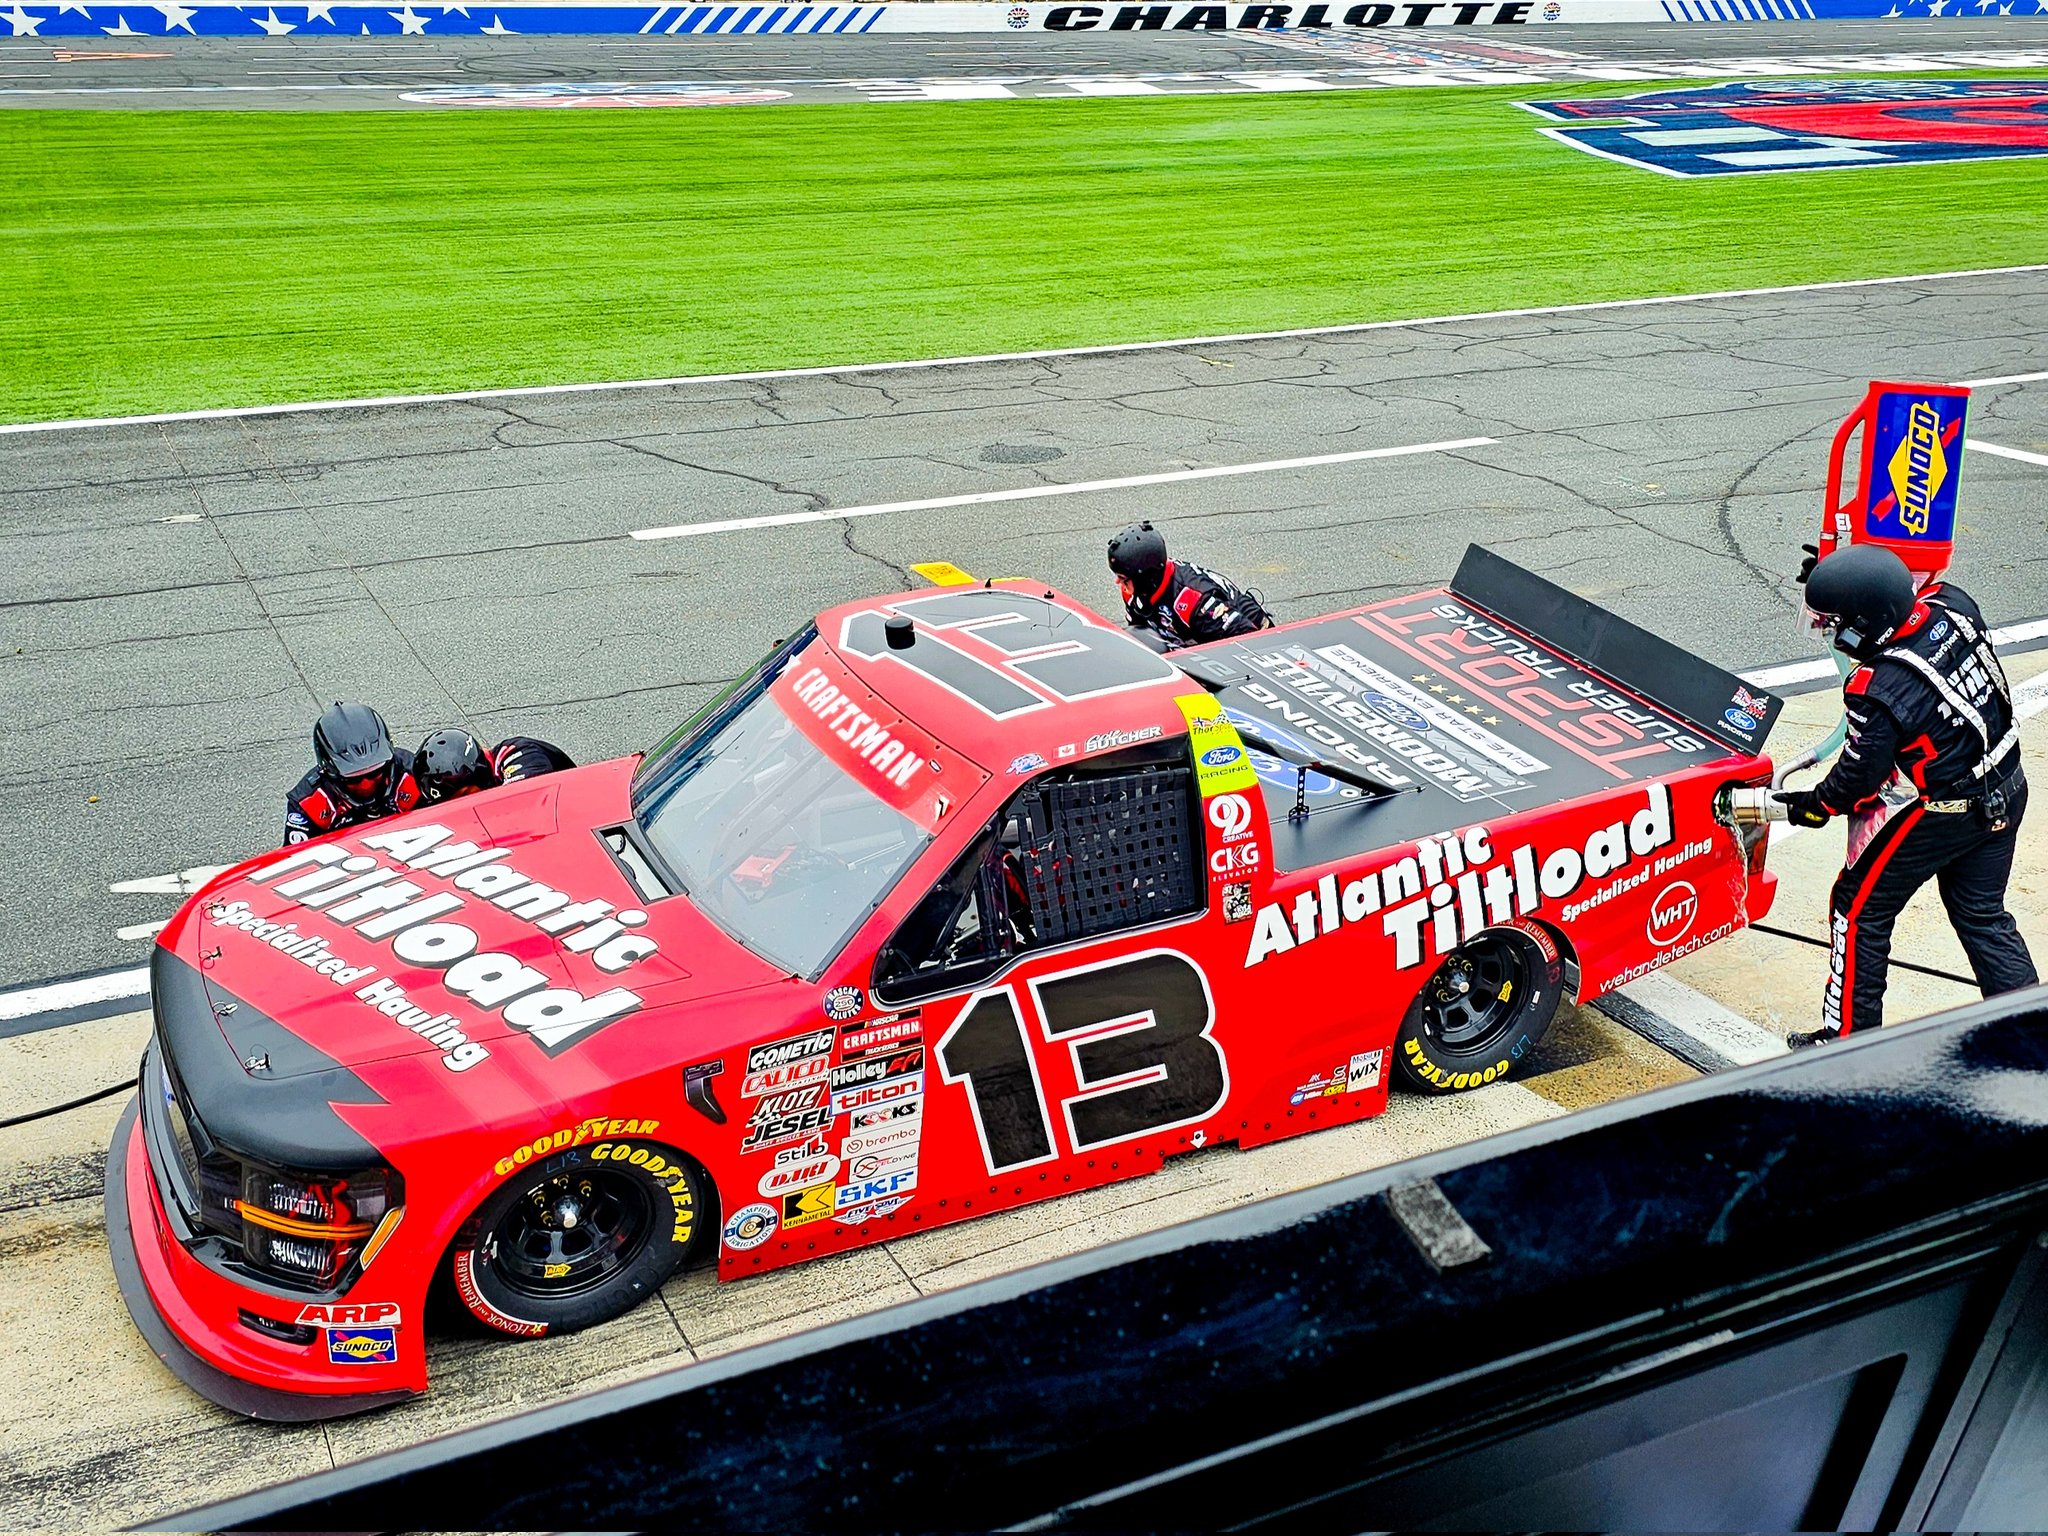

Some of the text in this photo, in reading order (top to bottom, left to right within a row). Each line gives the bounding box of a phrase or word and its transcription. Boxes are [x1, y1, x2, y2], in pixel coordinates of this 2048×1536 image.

[1043, 2, 1548, 31] CHARLOTTE
[1903, 408, 1937, 529] SUNOCO
[1876, 627, 1894, 646] VIPER
[1431, 604, 1705, 754] SUPER TRUCKS
[1250, 651, 1493, 798] MOORESVILLE
[1330, 648, 1535, 769] FIVE STAR EXPERIENCE
[792, 667, 925, 787] CRAFTSMAN
[1084, 726, 1163, 753] BUTCHER
[1238, 682, 1413, 789] RACING
[1717, 720, 1753, 742] RACING
[1200, 765, 1249, 780] RACING
[1222, 831, 1254, 844] CREATIVE
[1210, 842, 1259, 873] CKG
[1383, 782, 1674, 971] Tiltload
[1561, 836, 1713, 923] Specialized Hauling
[359, 824, 659, 973] Atlantic
[1244, 827, 1495, 969] Atlantic
[1650, 899, 1695, 932] WHT
[248, 844, 645, 1050] Tiltload
[1524, 921, 1556, 959] REMEMBER
[1599, 922, 1732, 993] wehandletech.com
[209, 900, 491, 1073] Specialized Hauling
[827, 986, 859, 1002] NASCAR
[828, 1004, 862, 1020] SALUTES
[835, 999, 855, 1008] 250
[750, 1032, 832, 1069] COMETIC
[843, 1021, 919, 1049] CRAFTSMAN
[745, 1059, 827, 1093] CALICO
[832, 1061, 886, 1087] Holley
[933, 947, 1230, 1177] 13
[1350, 1060, 1379, 1082] WIX
[1404, 1037, 1510, 1089] GOODYEAR
[757, 1086, 822, 1117] KLOTZ
[837, 1079, 917, 1109] tilton
[744, 1107, 831, 1146] JESEL
[866, 1128, 917, 1148] brembo
[494, 1116, 660, 1176] GOODYEAR
[778, 1142, 825, 1165] Stilo
[590, 1143, 694, 1243] GOODYEAR
[838, 1171, 914, 1205] SKF
[730, 1206, 772, 1226] CHAMPION
[784, 1210, 832, 1228] KENNAMETAL
[728, 1226, 773, 1248] IRRIGATION
[457, 1253, 481, 1310] REMEMBER
[300, 1304, 398, 1324] ARP
[487, 1314, 532, 1335] HONOR
[335, 1340, 390, 1352] SUNOCO
